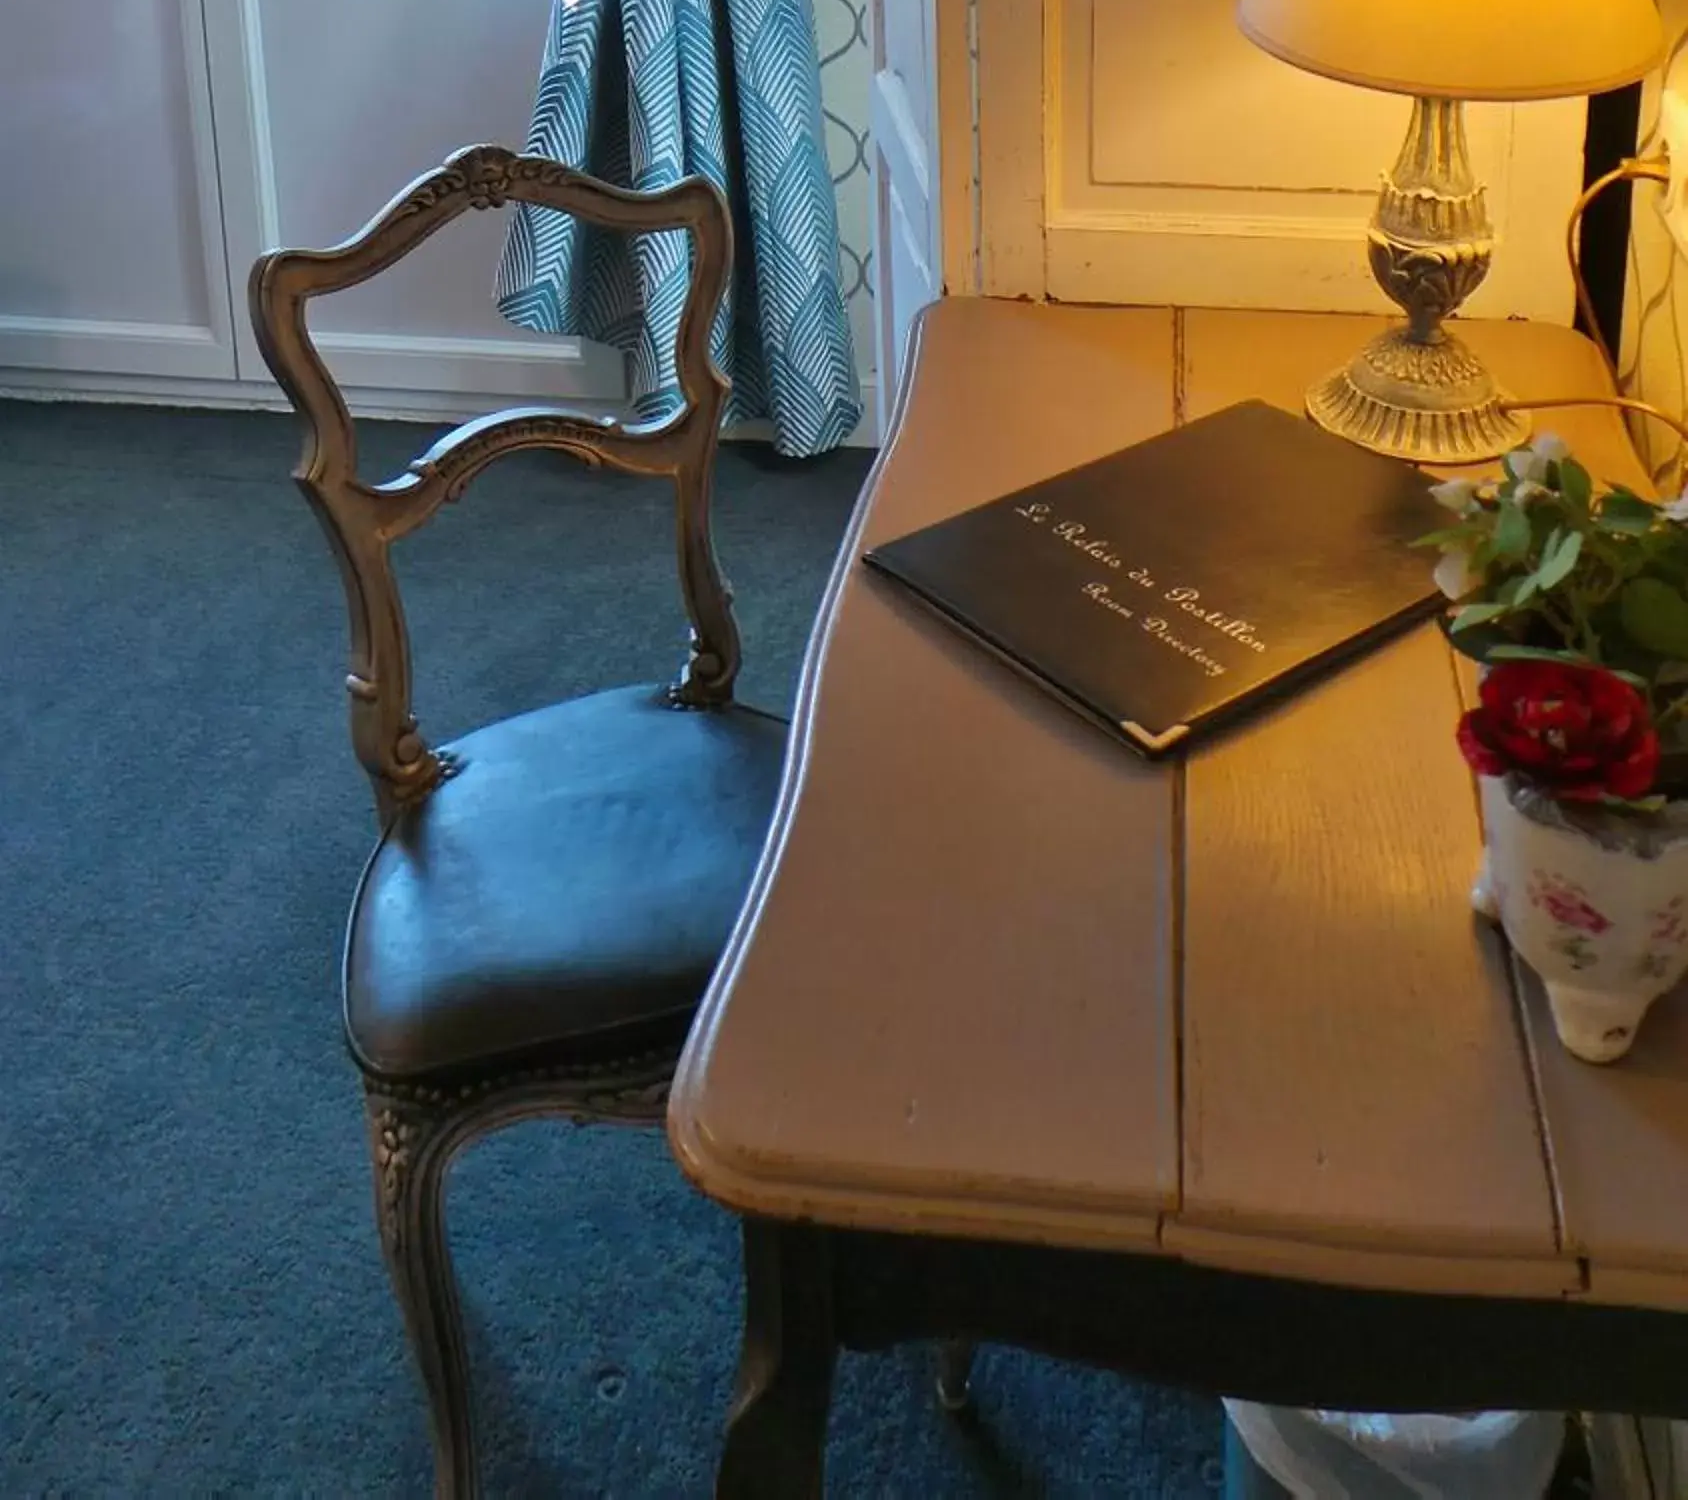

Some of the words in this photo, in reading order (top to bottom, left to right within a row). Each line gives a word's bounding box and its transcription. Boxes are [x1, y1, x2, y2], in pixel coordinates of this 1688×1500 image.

[1014, 502, 1051, 523] Le
[1052, 520, 1121, 569] Relais
[1128, 567, 1154, 588] du
[1164, 586, 1265, 653] Postillon
[1081, 581, 1134, 619] Room
[1140, 616, 1226, 677] Directory
